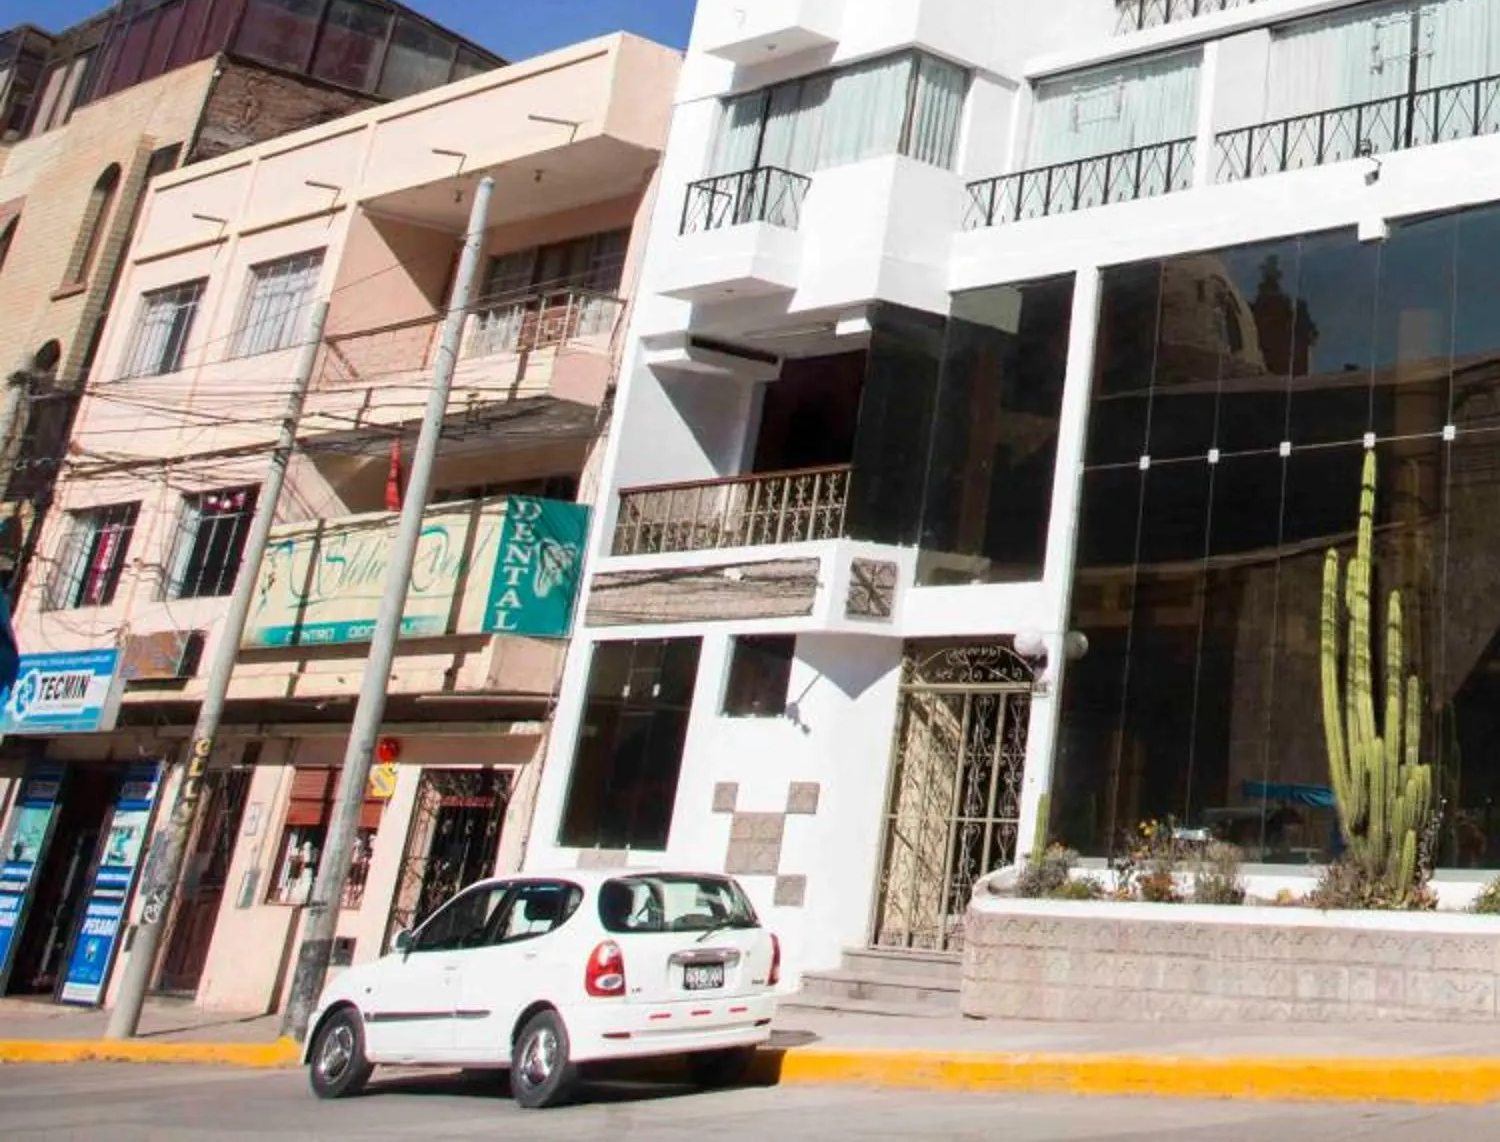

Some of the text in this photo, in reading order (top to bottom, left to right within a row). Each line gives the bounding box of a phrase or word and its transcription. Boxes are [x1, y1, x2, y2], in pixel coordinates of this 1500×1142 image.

[491, 499, 543, 631] DENTAL
[284, 627, 335, 647] CNTRO
[38, 673, 91, 701] TECMIN
